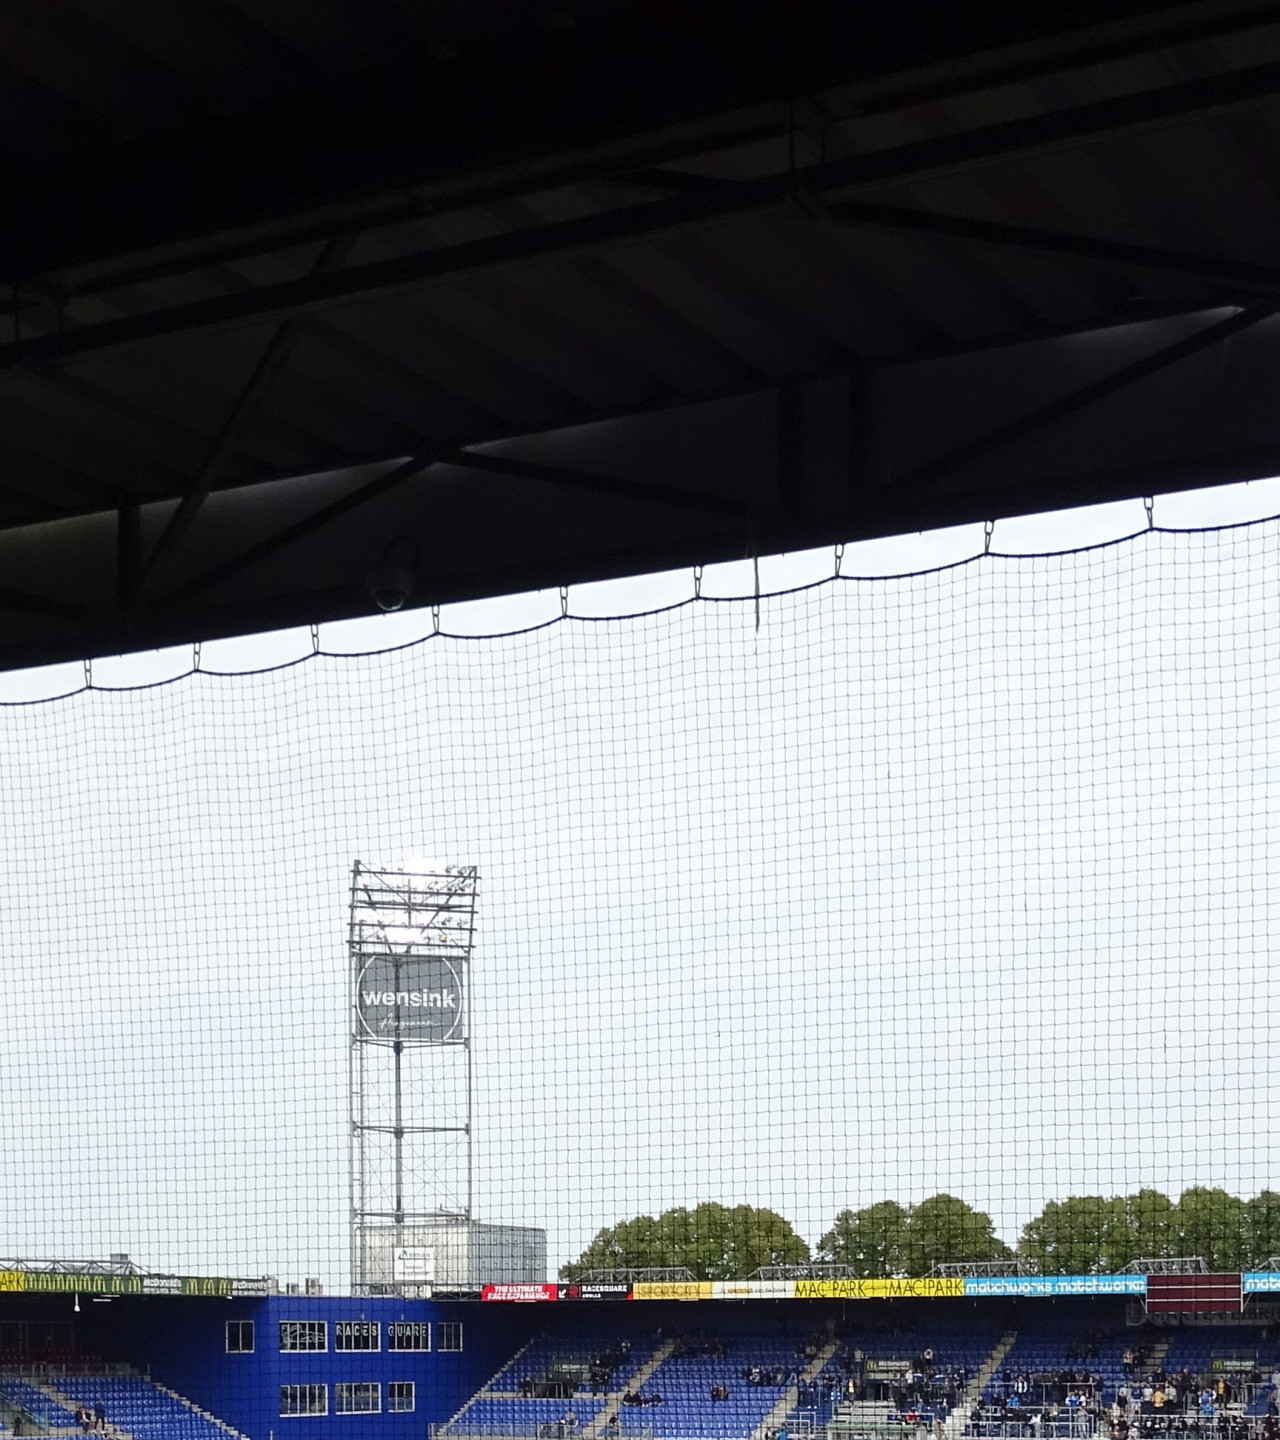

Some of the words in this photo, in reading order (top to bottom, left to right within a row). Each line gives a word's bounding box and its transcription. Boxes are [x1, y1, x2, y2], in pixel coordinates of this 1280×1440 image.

[362, 988, 455, 1009] wensink
[965, 1279, 1052, 1295] matchworks
[1056, 1277, 1145, 1293] matchworks
